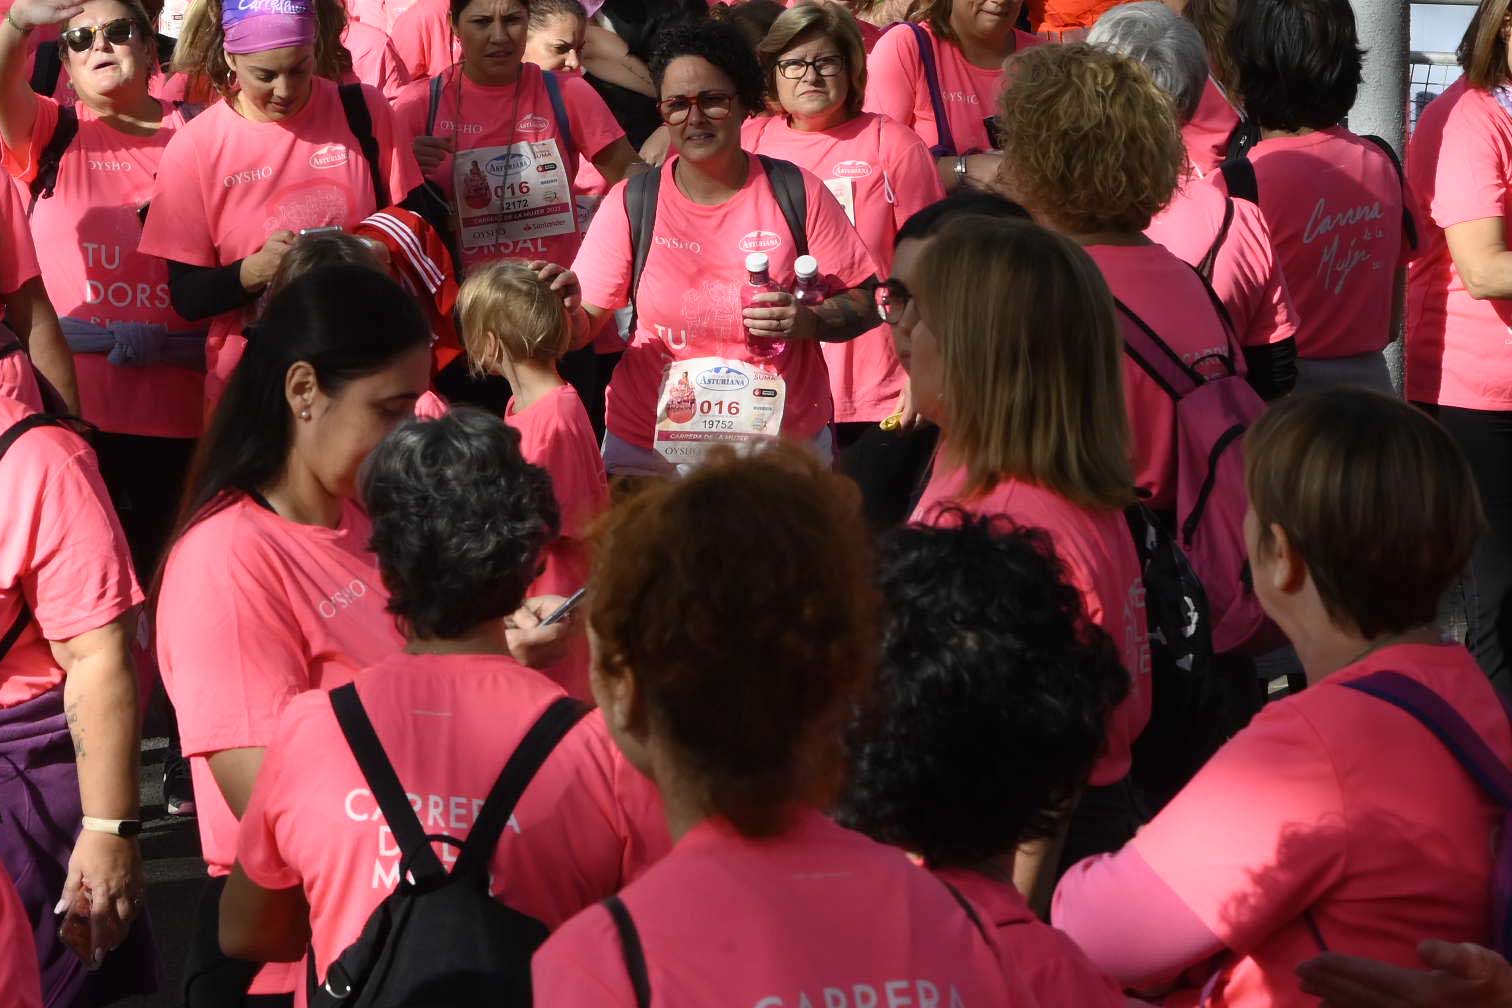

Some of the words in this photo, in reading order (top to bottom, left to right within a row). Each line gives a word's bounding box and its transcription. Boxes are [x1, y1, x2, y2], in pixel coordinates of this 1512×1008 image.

[440, 120, 483, 134] OYHO
[224, 166, 273, 188] OYSHO
[494, 181, 530, 198] 016
[501, 199, 529, 210] 2172
[533, 220, 566, 230] Santander
[84, 243, 120, 270] TU
[87, 280, 170, 309] DORS
[654, 323, 687, 350] TU
[700, 374, 745, 386] ASTURIANA
[700, 400, 740, 416] 016
[703, 420, 734, 430] 19752
[344, 788, 521, 834] CRRE
